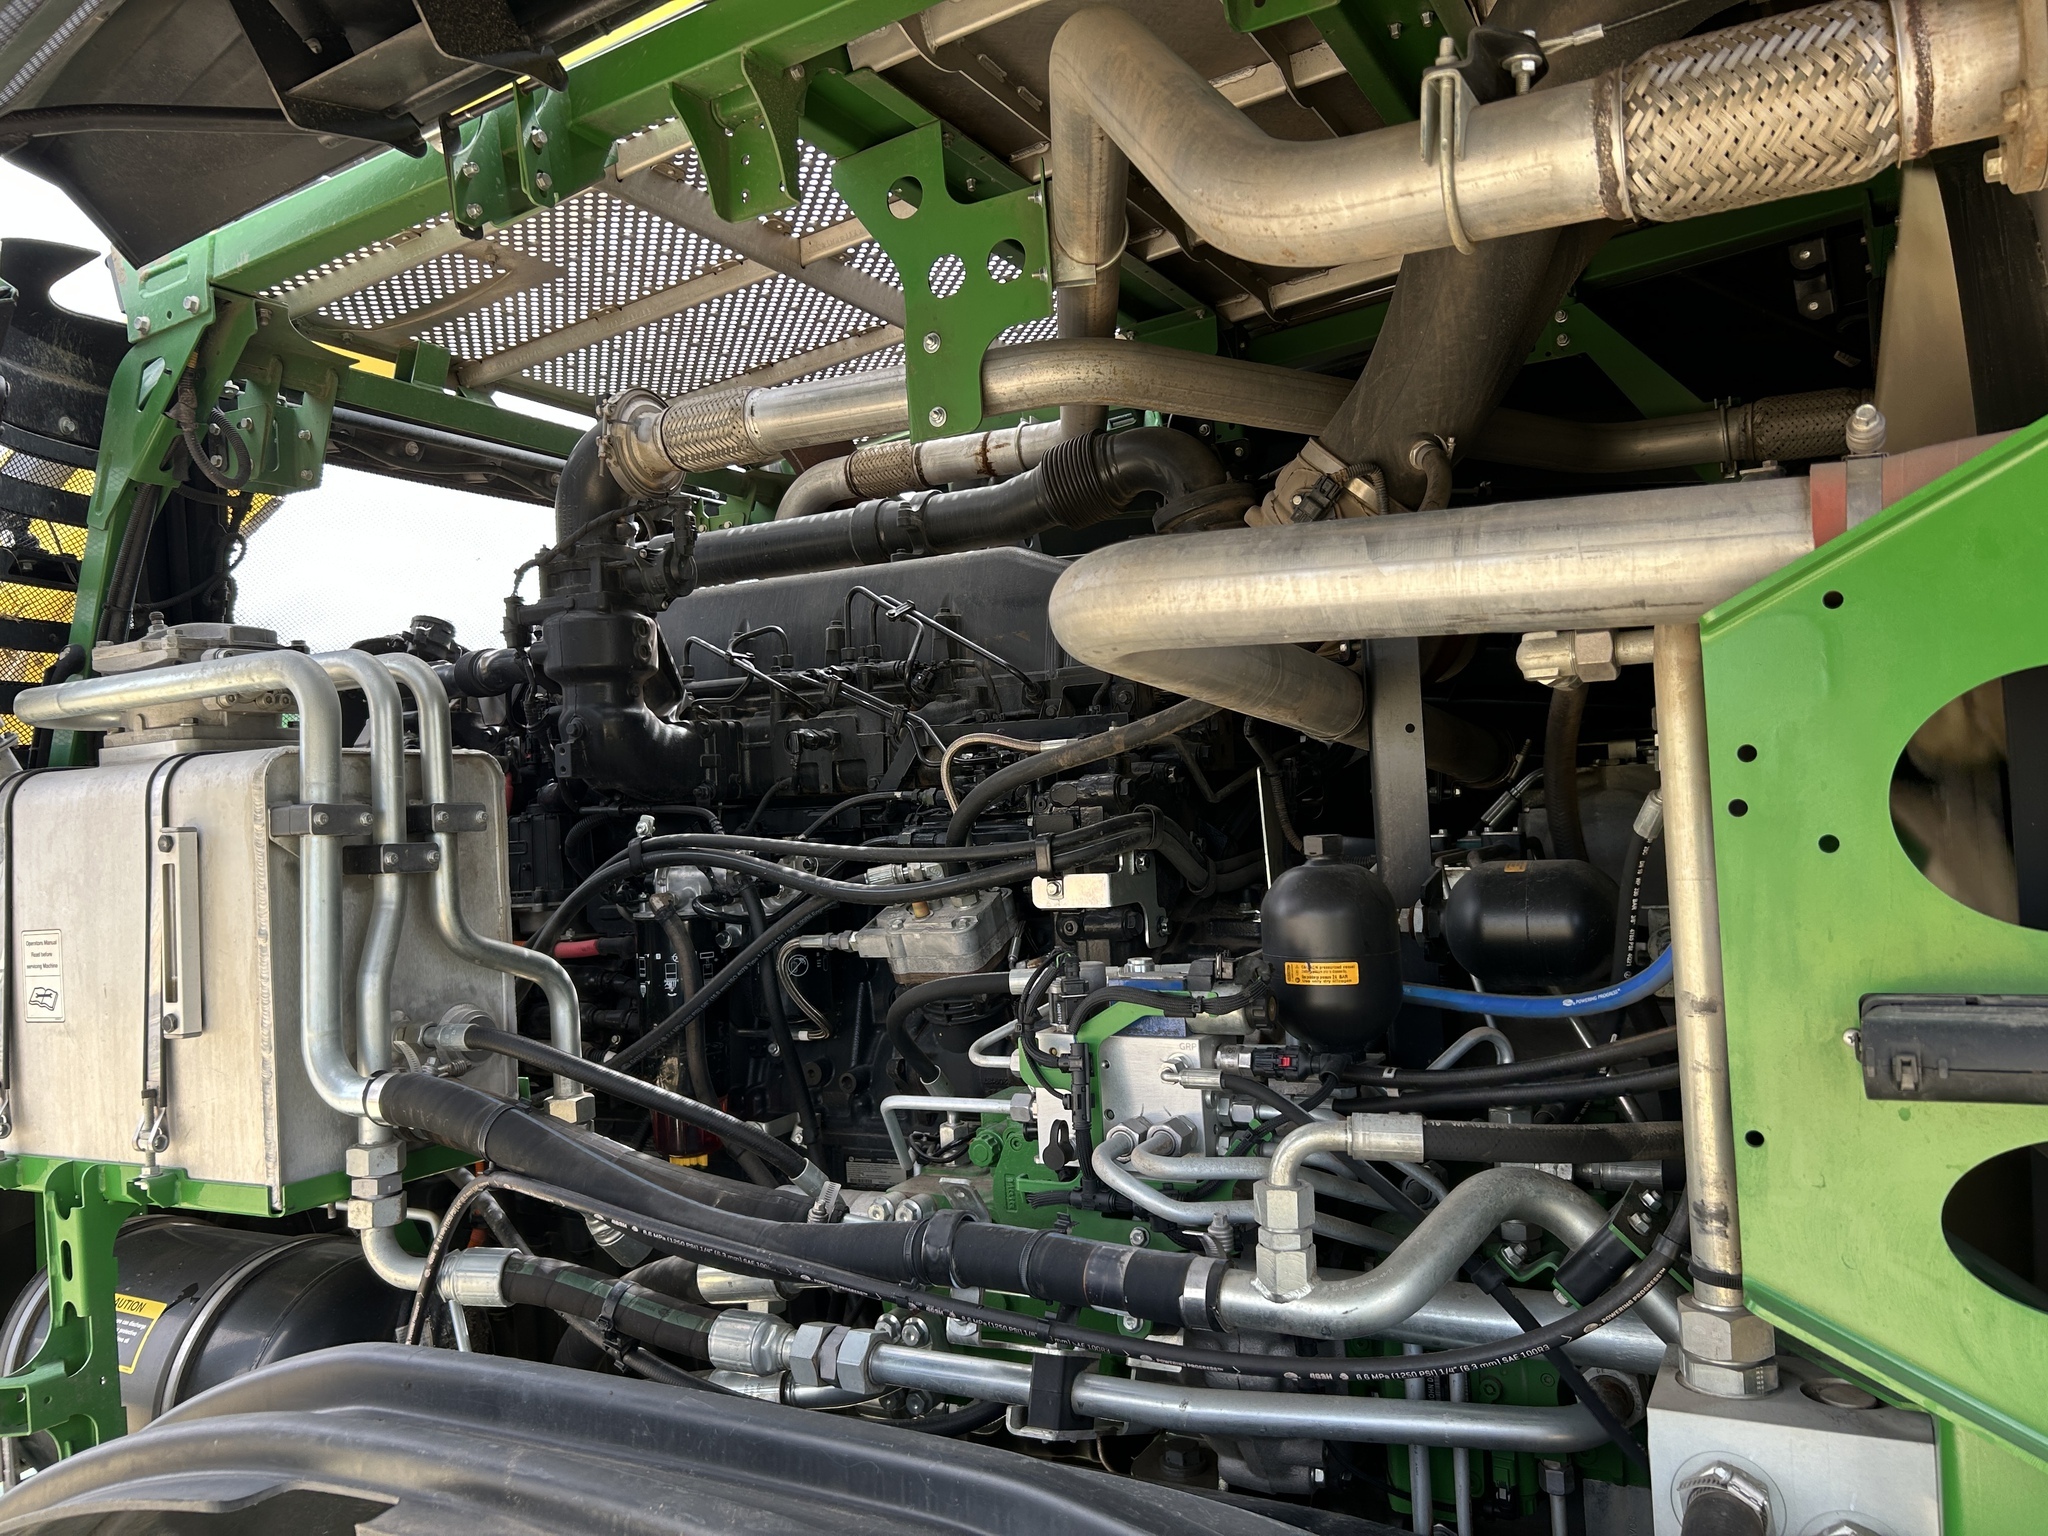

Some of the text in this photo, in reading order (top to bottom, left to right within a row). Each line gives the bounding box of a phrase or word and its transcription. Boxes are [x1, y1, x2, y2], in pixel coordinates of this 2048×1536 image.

[729, 975, 739, 985] ISO
[747, 957, 760, 969] Type
[1179, 1042, 1197, 1051] GRP
[115, 1298, 147, 1312] AUTION
[1600, 1298, 1634, 1324] POWERING
[1371, 1372, 1389, 1380] MPa
[1439, 1366, 1457, 1375] 1/4"
[1479, 1358, 1501, 1369] mm)
[1501, 1353, 1521, 1364] SAE
[1519, 1343, 1551, 1358] 100R3
